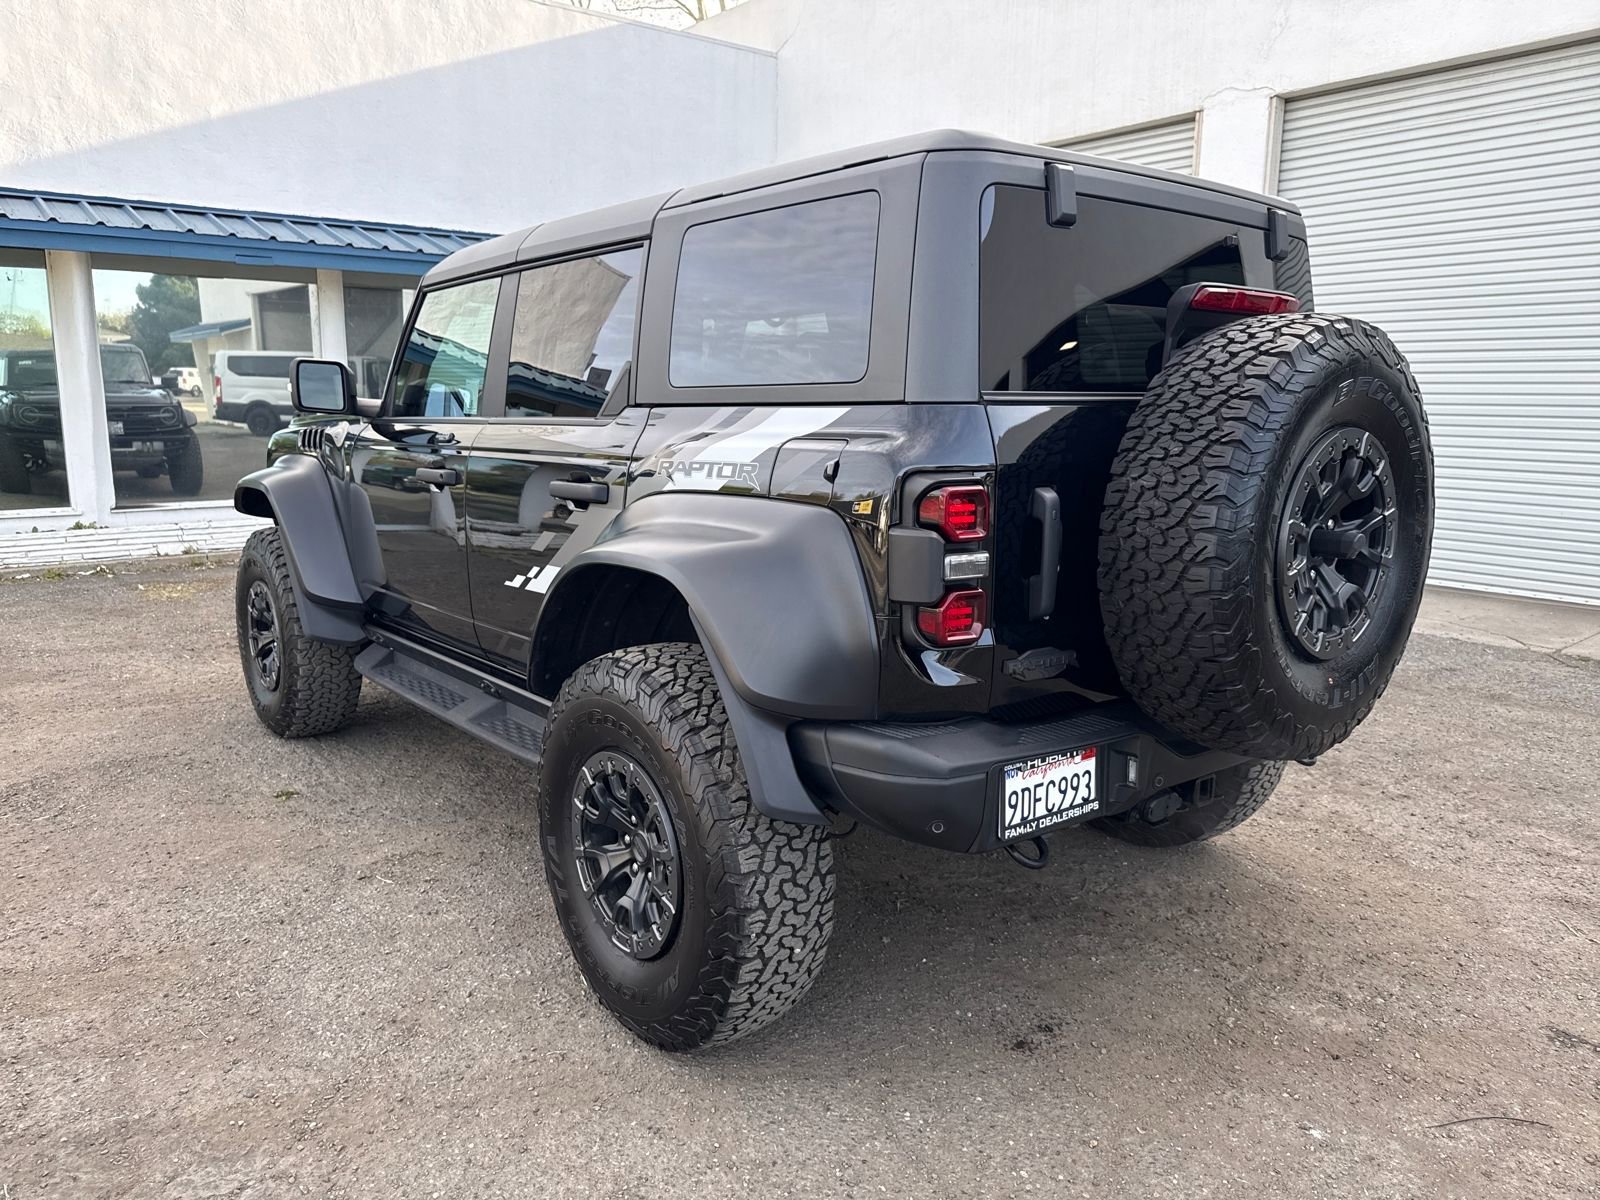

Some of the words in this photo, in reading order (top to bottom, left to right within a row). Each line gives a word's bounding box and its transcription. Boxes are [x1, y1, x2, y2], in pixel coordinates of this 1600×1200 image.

[656, 458, 761, 492] RAPTOR
[1008, 770, 1092, 828] 9DFC993
[1005, 821, 1038, 840] FAMILY
[1039, 801, 1099, 829] DEALERSHIPS
